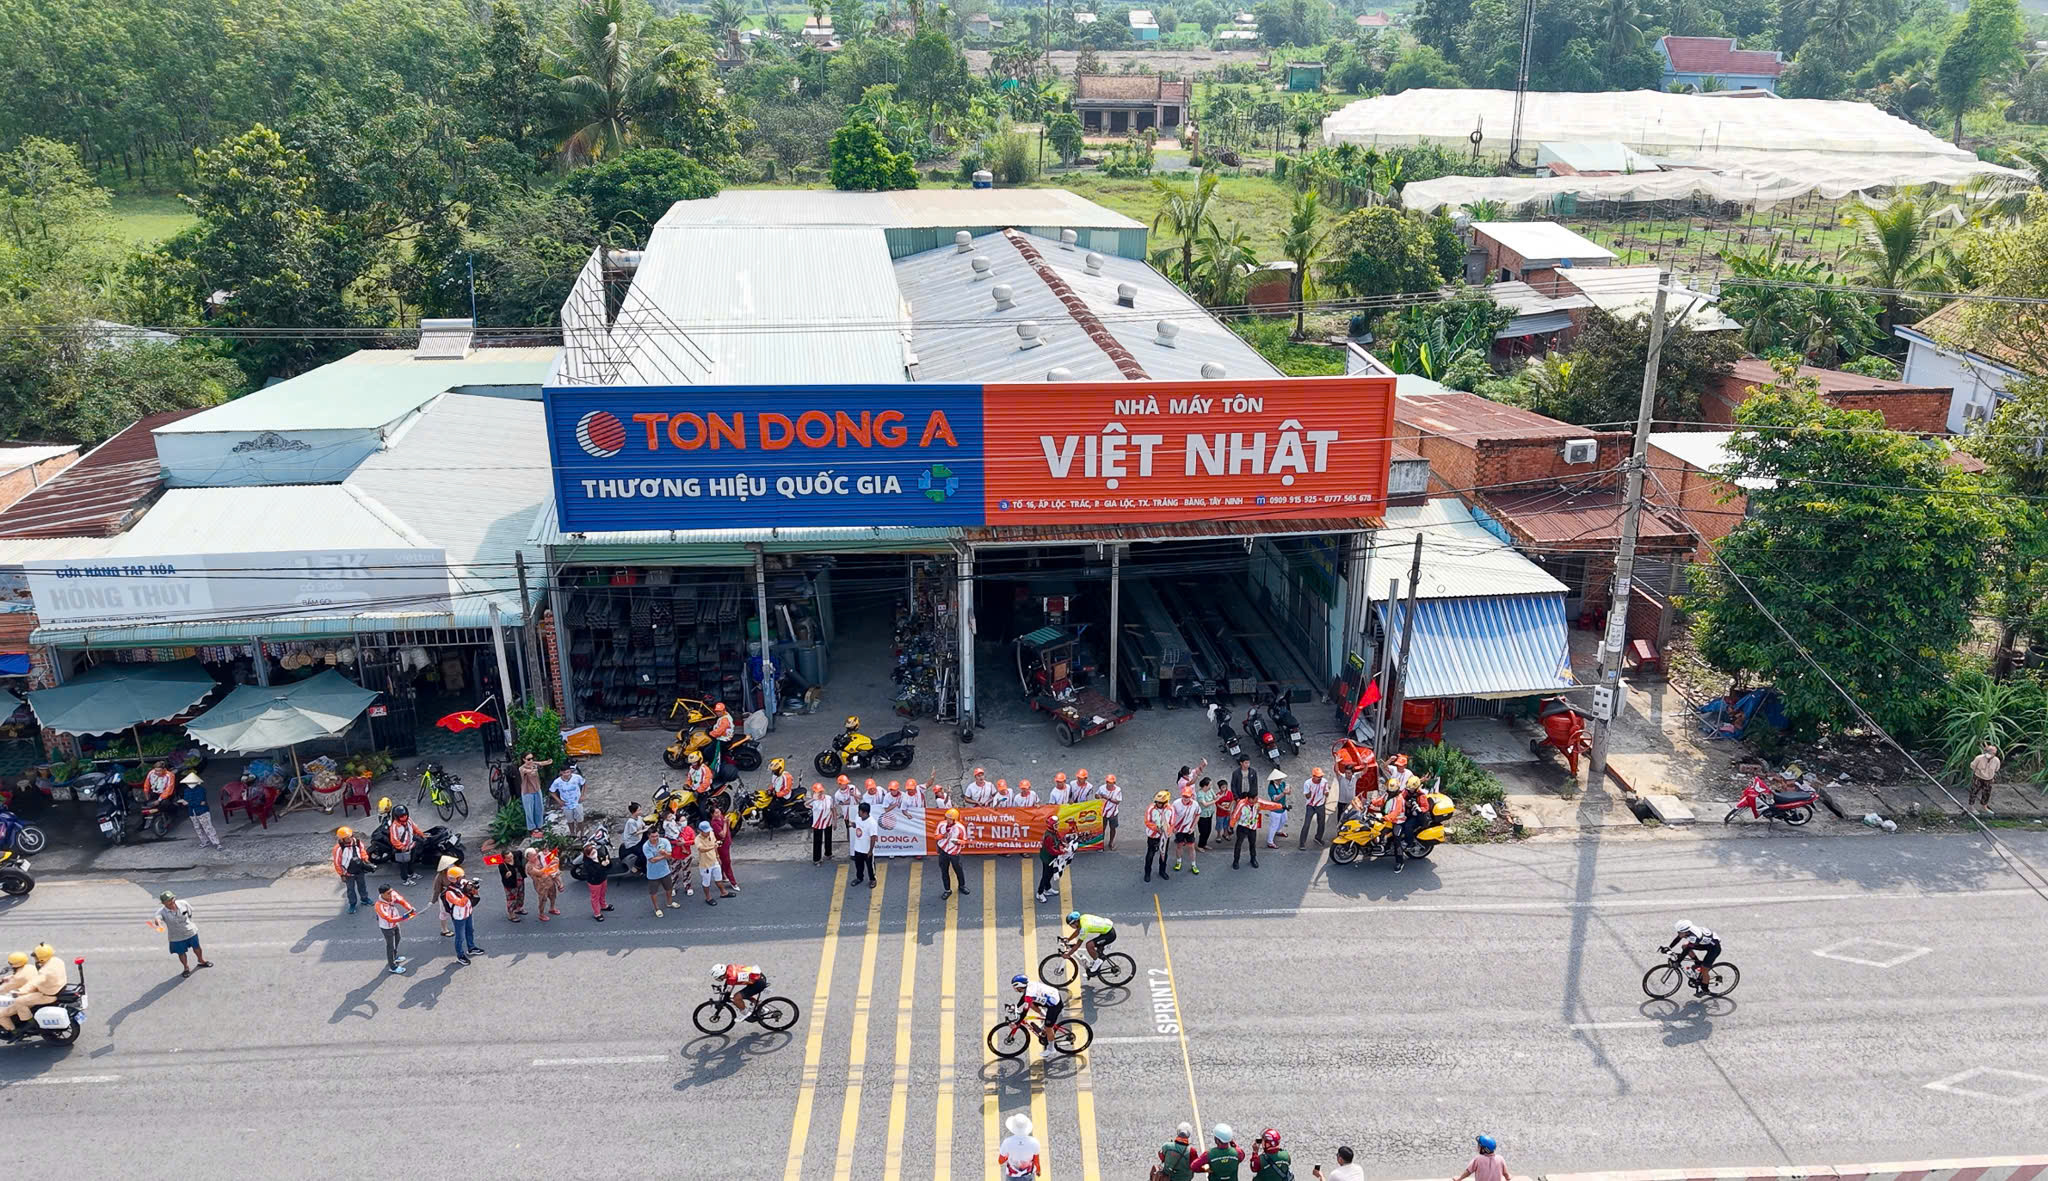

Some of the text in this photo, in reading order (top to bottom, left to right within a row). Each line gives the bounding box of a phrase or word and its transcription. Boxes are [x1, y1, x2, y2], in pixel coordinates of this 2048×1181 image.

[1114, 393, 1263, 416] NHÀ MÁY TÔN
[632, 409, 959, 450] TON DONG A
[1039, 418, 1339, 490] VIỆT NHẬT
[582, 469, 902, 502] THƯƠNG HIỆU QUỐC GIA
[1051, 499, 1066, 510] LỘC
[1104, 499, 1117, 508] GIA
[1120, 499, 1136, 509] LỘC,
[1153, 497, 1178, 507] TRẢNG
[1208, 496, 1222, 506] TÂY
[1224, 497, 1243, 505] NINH
[1269, 496, 1287, 504] 0909
[1289, 495, 1302, 504] 915
[1304, 495, 1317, 503] 925
[1324, 495, 1341, 503] 0777
[964, 813, 1015, 823] NHÀ MÁY TÔN
[880, 835, 910, 843] DONG
[911, 835, 919, 843] A
[966, 822, 1030, 842] ỆT NHẬT
[1147, 968, 1180, 1034] SPRINT 2
